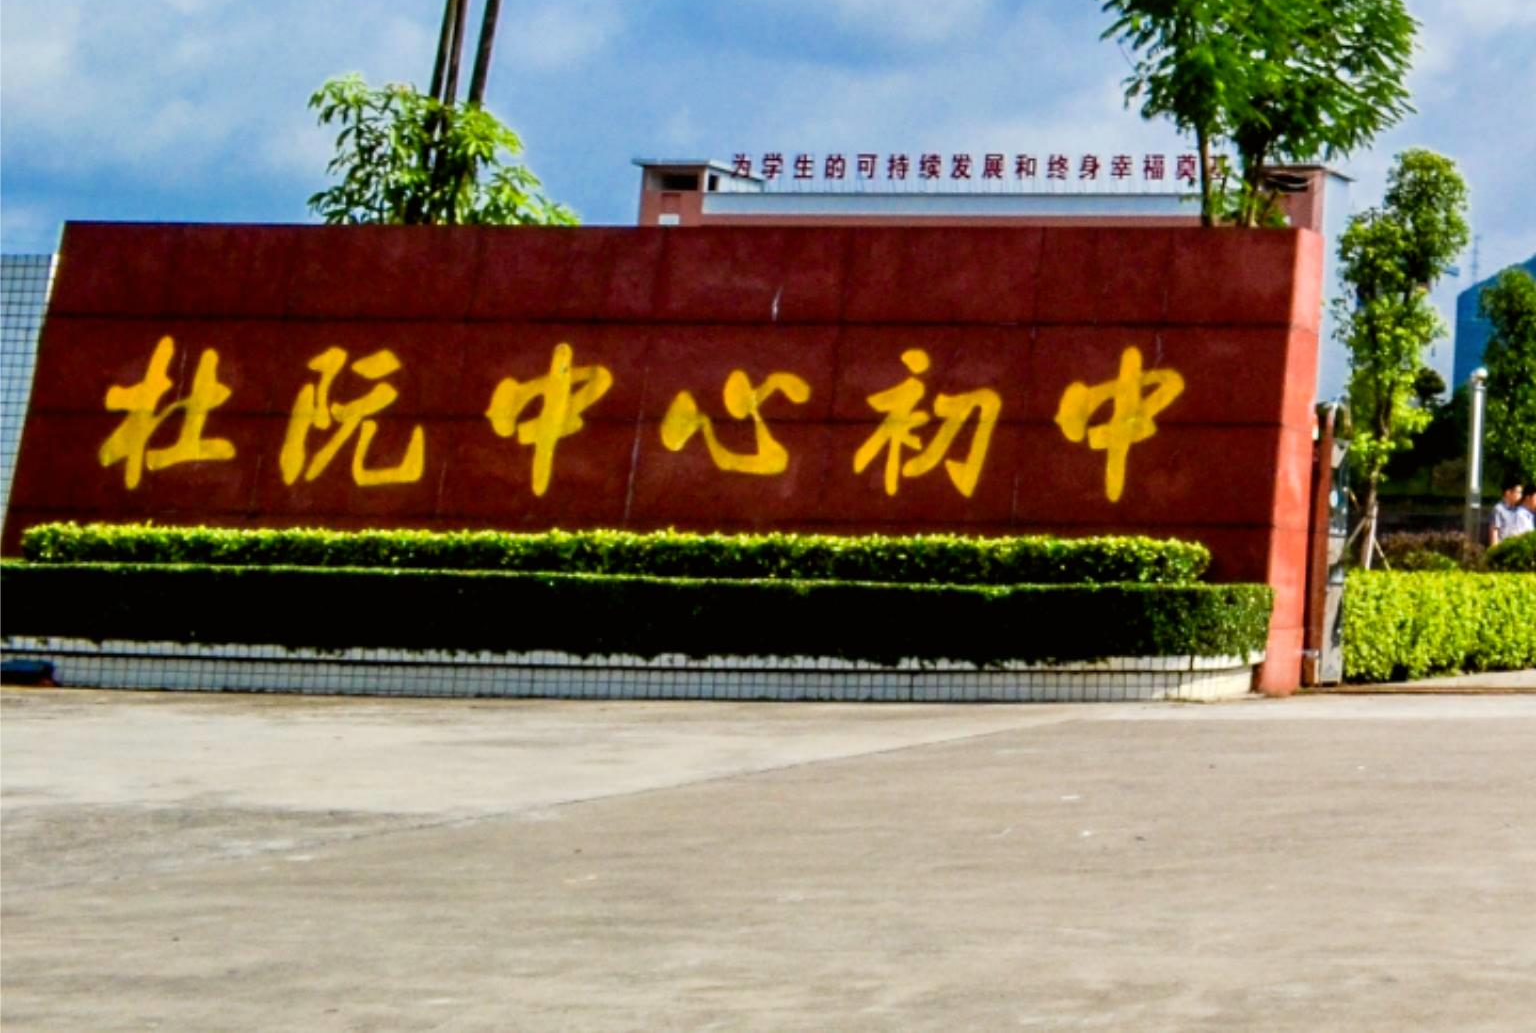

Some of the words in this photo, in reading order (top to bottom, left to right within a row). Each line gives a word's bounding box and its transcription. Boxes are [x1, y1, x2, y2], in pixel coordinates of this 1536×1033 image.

[98, 335, 1186, 502] 杜阮中心初中
